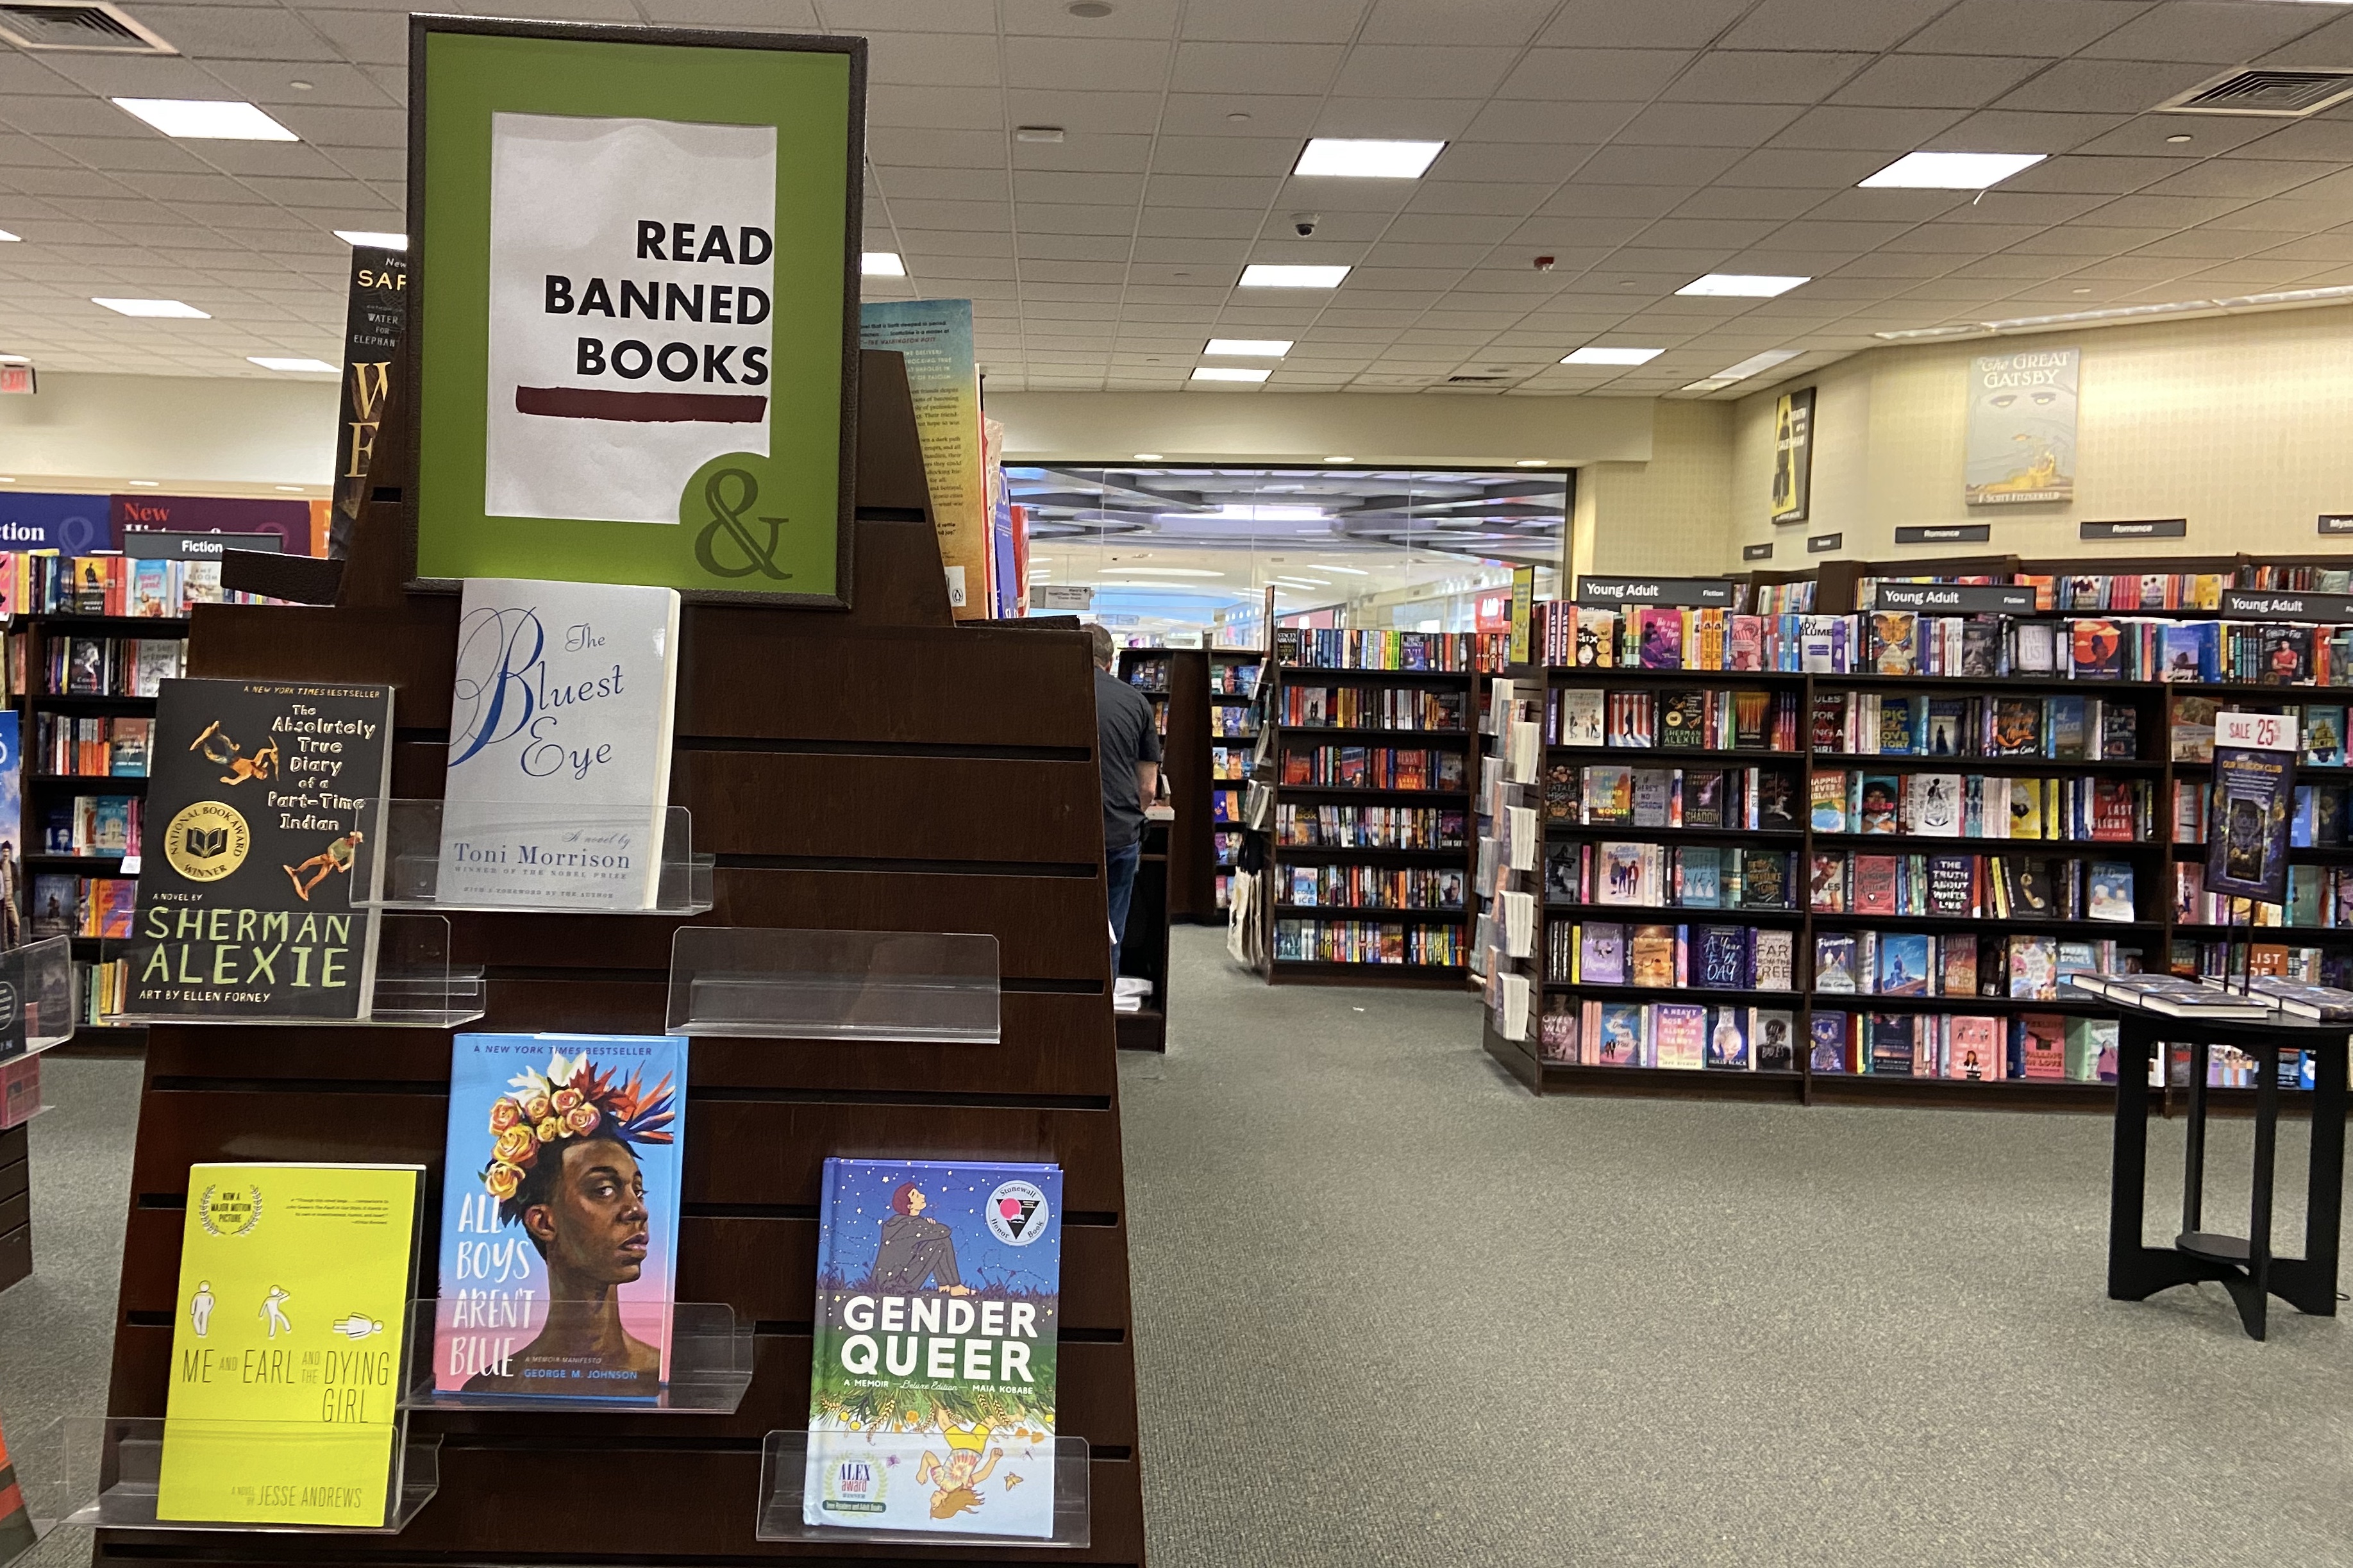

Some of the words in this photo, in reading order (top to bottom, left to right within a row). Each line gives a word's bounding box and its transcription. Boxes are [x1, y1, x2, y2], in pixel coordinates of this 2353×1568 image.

[637, 220, 772, 265] READ
[545, 276, 770, 324] BANNED
[368, 313, 398, 324] WATER
[354, 335, 395, 347] ELEPHAN
[576, 338, 768, 385] BOOKS
[1977, 357, 2008, 372] The
[2013, 352, 2070, 370] GREAT
[1984, 369, 2059, 388] GATSBY
[123, 503, 169, 522] New
[0, 522, 46, 541] tion
[1924, 530, 1959, 538] Romance
[2112, 523, 2152, 533] Romance
[181, 540, 223, 553] Fiction
[1587, 583, 1625, 597] Young
[1627, 584, 1659, 596] Adult
[1703, 589, 1723, 597] Fiction
[1885, 591, 1923, 605] Young
[1926, 592, 1959, 604] Adult
[2232, 598, 2268, 613] Young
[2271, 599, 2303, 612] Adult
[565, 623, 605, 651] The
[327, 689, 380, 698] BESTSELLER
[292, 705, 316, 715] The
[272, 717, 376, 739] Absolutely
[2229, 722, 2250, 739] SALE
[297, 737, 342, 753] True
[521, 716, 612, 780] Eye
[290, 756, 342, 777] Diary
[298, 776, 316, 788] of
[320, 780, 328, 788] a
[268, 791, 366, 810] Part-Time
[280, 813, 339, 831] Indian
[1686, 812, 1719, 822] SHADOW
[170, 809, 200, 855] NATIONAL
[203, 807, 233, 821] BOOK
[231, 821, 245, 857] AWARD
[562, 830, 584, 842] A
[584, 835, 615, 844] novel
[618, 834, 631, 850] by
[454, 843, 507, 863] Toni
[517, 846, 630, 869] Morrison
[184, 864, 228, 876] WINNER
[1933, 871, 1968, 879] TRUTH
[145, 906, 351, 944] SHERMAN
[142, 942, 349, 987] ALEXIE
[1707, 963, 1736, 981] DAY
[139, 990, 160, 999] ART
[165, 990, 180, 1000] BY
[183, 991, 221, 1002] ELLEN
[225, 992, 271, 1003] FORNEY
[548, 1046, 581, 1055] TIMES
[586, 1047, 652, 1056] BESTSELLER
[1000, 1187, 1036, 1197] Stonewall
[458, 1192, 501, 1234] ALL
[991, 1219, 1010, 1239] Honor
[1027, 1221, 1043, 1238] Book
[456, 1238, 530, 1283] BOYS
[452, 1287, 536, 1329] AREN'T
[843, 1296, 1038, 1338] GENDER
[182, 1349, 215, 1383] ME
[219, 1356, 238, 1371] AND
[242, 1349, 296, 1383] EARL
[302, 1351, 320, 1365] AND
[449, 1337, 515, 1378] BLUE
[841, 1333, 1035, 1383] QUEER
[302, 1369, 318, 1383] THE
[324, 1350, 390, 1386] DYING
[524, 1369, 565, 1378] GEORGE
[587, 1370, 637, 1379] JOHNSON
[854, 1380, 889, 1388] MEMOIR
[900, 1380, 929, 1389] Deluxe
[931, 1381, 959, 1391] Edition
[999, 1385, 1034, 1394] KOBABE
[322, 1388, 369, 1423] GIRL
[839, 1464, 871, 1481] ALEX
[842, 1480, 867, 1492] award
[258, 1485, 297, 1506] JESSE
[301, 1486, 362, 1508] ANDREWS
